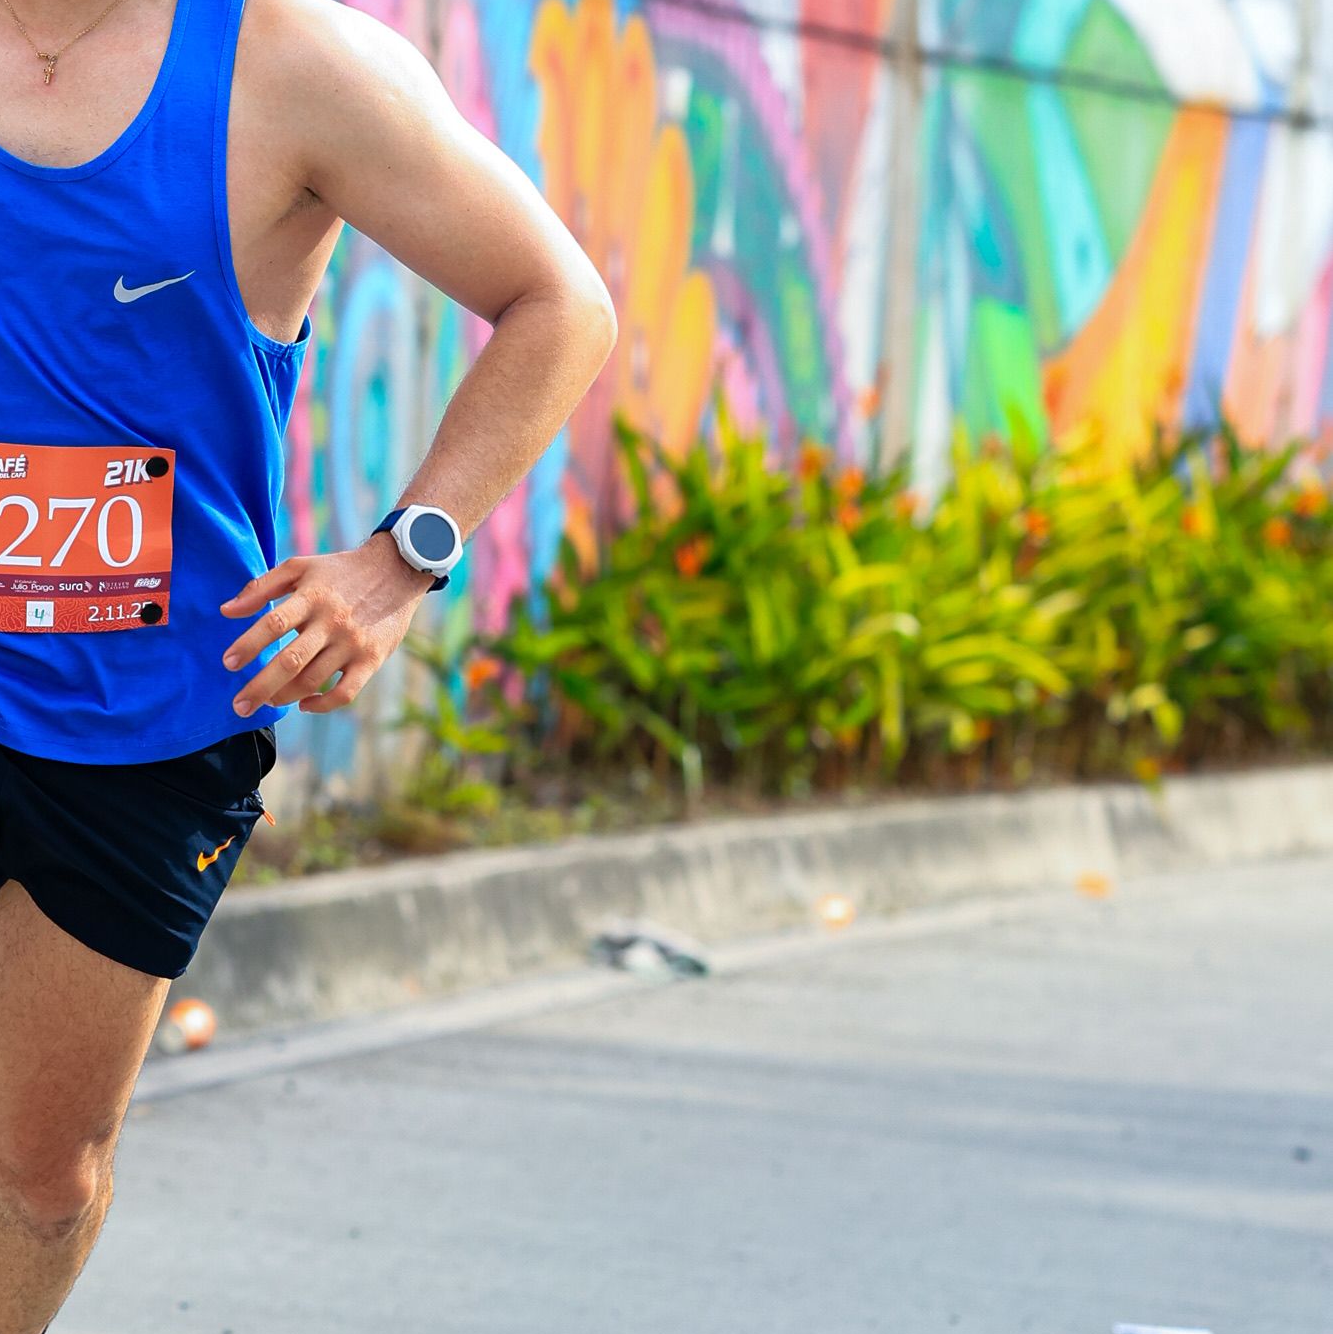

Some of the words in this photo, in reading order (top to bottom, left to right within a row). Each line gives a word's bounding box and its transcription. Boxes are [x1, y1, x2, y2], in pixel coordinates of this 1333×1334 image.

[11, 471, 26, 479] CAFÉ
[104, 458, 151, 487] 21K
[59, 583, 83, 591] sura
[35, 608, 44, 625] 4
[88, 601, 152, 621] 2.11.2
